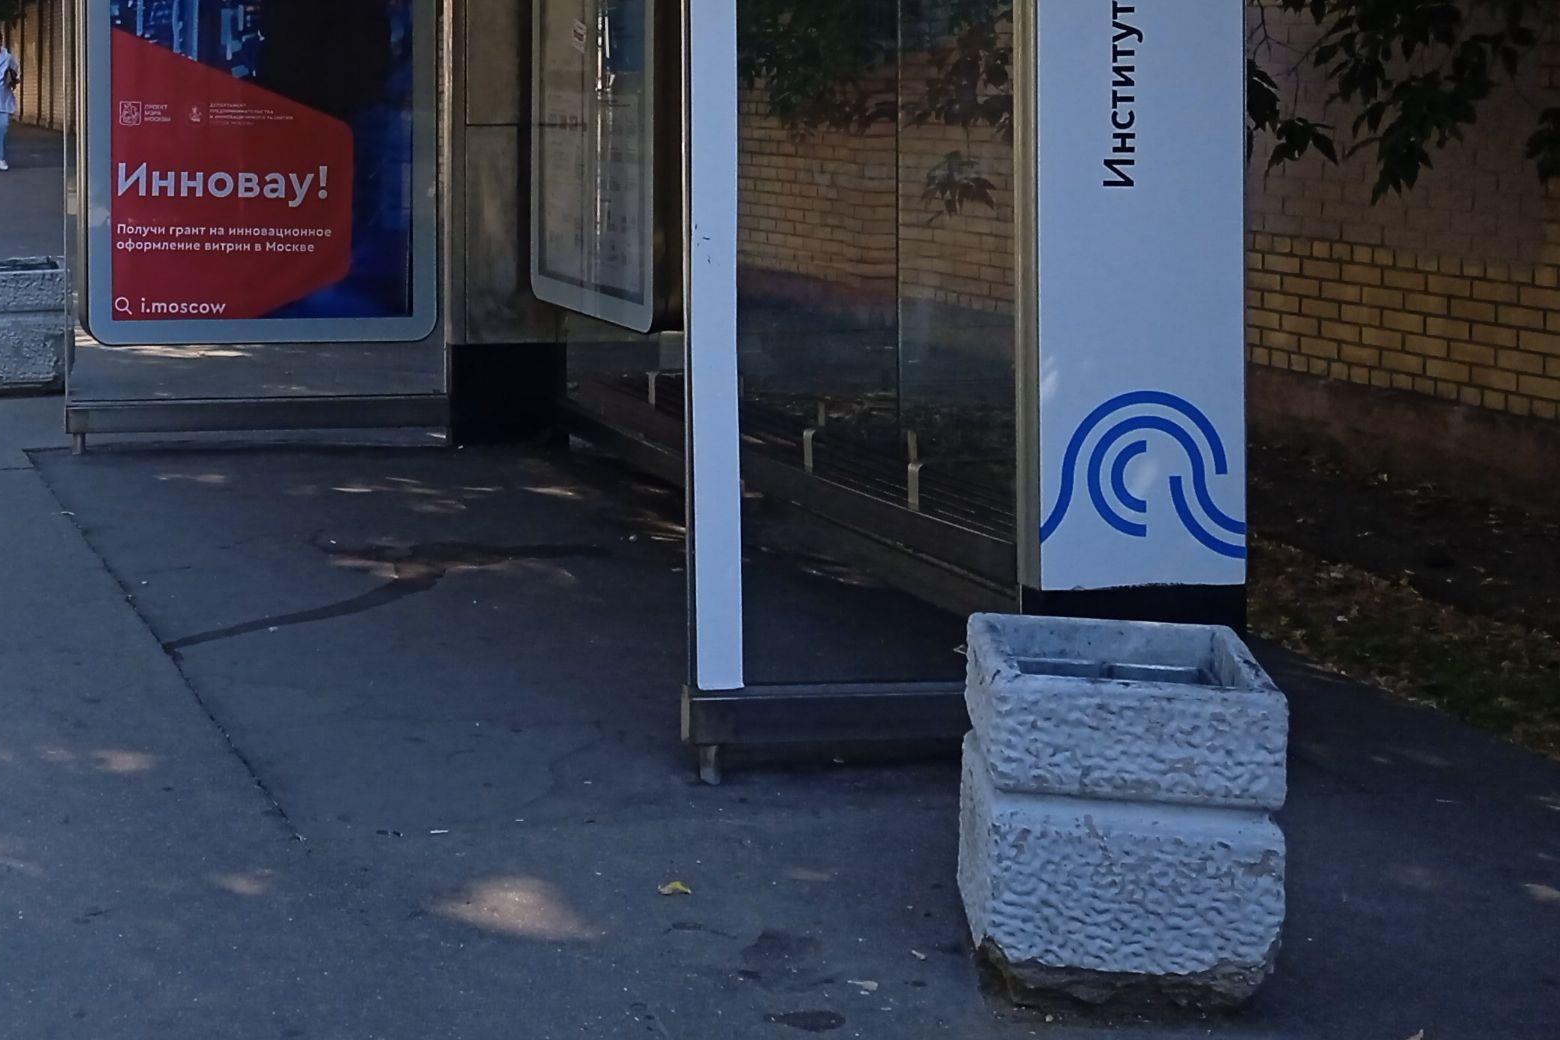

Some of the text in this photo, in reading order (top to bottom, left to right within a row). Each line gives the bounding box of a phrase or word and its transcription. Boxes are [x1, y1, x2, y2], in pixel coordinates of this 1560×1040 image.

[1102, 0, 1143, 188] Институт
[117, 162, 328, 207] Инновау!
[117, 223, 332, 239] Получи грант на инновационное
[116, 241, 315, 254] оформление витрин в Москве
[141, 298, 225, 314] i.moscow
